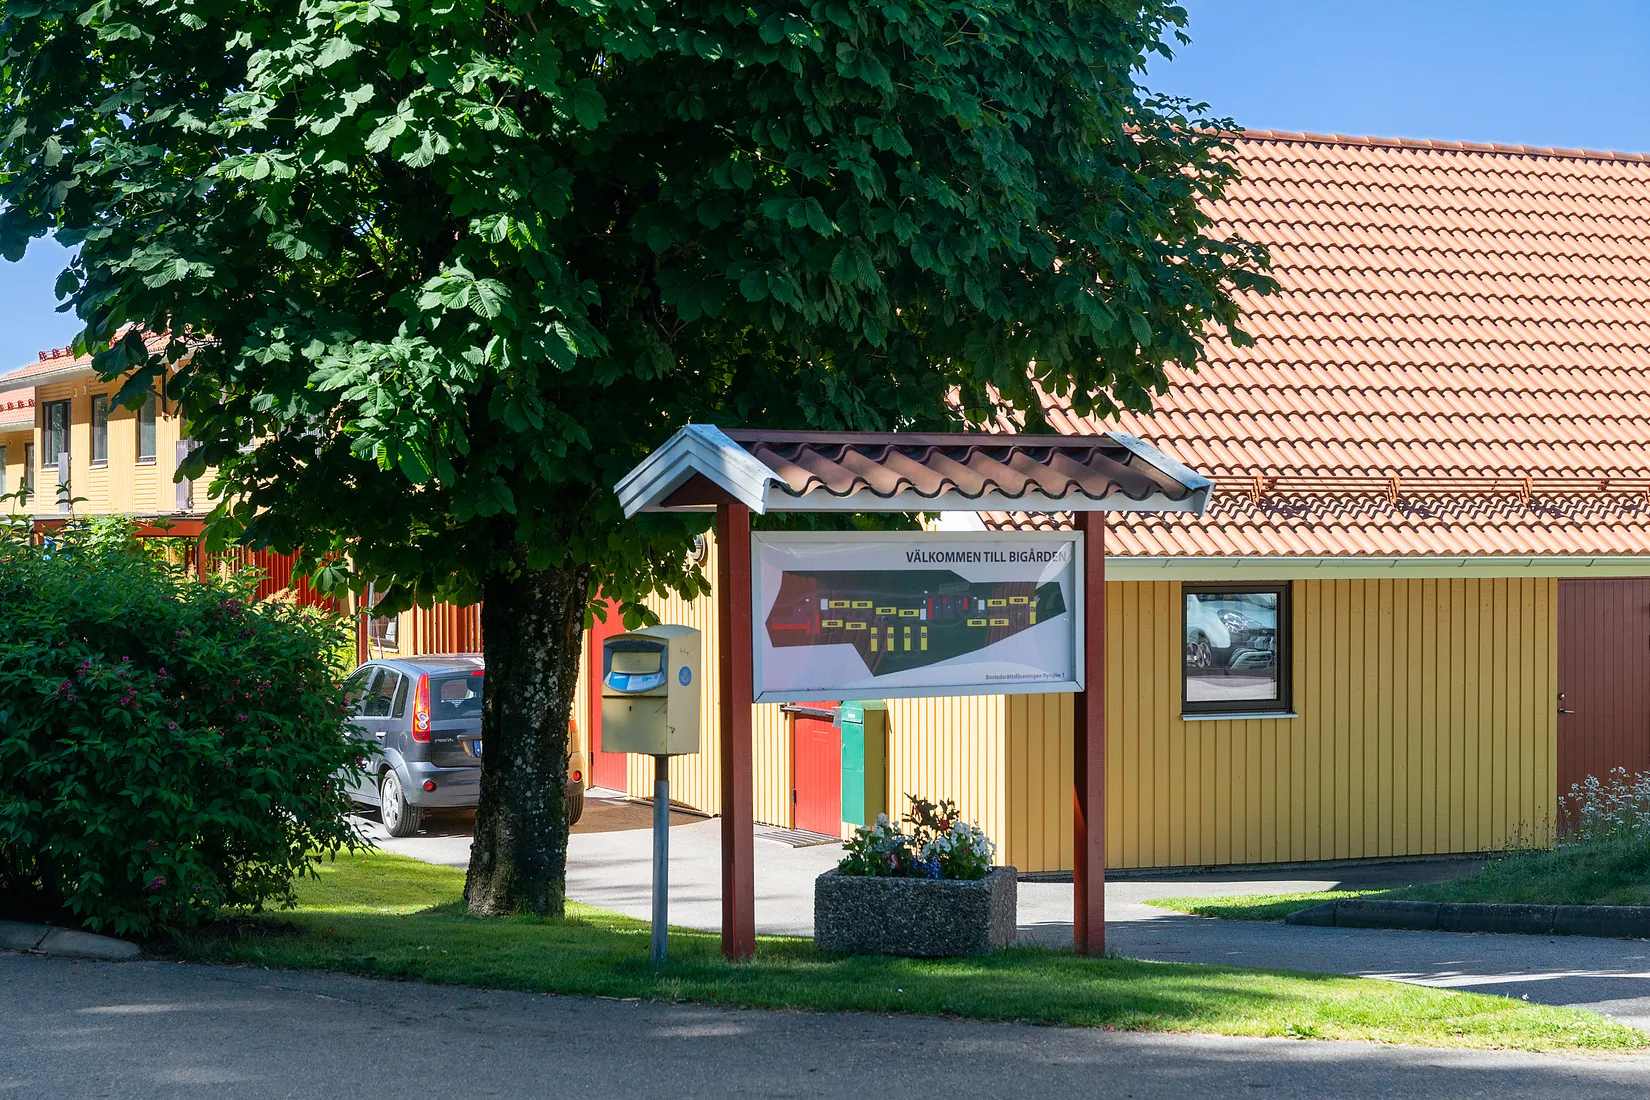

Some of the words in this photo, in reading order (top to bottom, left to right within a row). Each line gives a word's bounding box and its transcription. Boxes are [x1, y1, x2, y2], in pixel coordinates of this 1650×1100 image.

[906, 549, 981, 563] VÄLKOMMEN
[984, 551, 1007, 563] TILL
[1009, 548, 1067, 563] BIGÅRDEN
